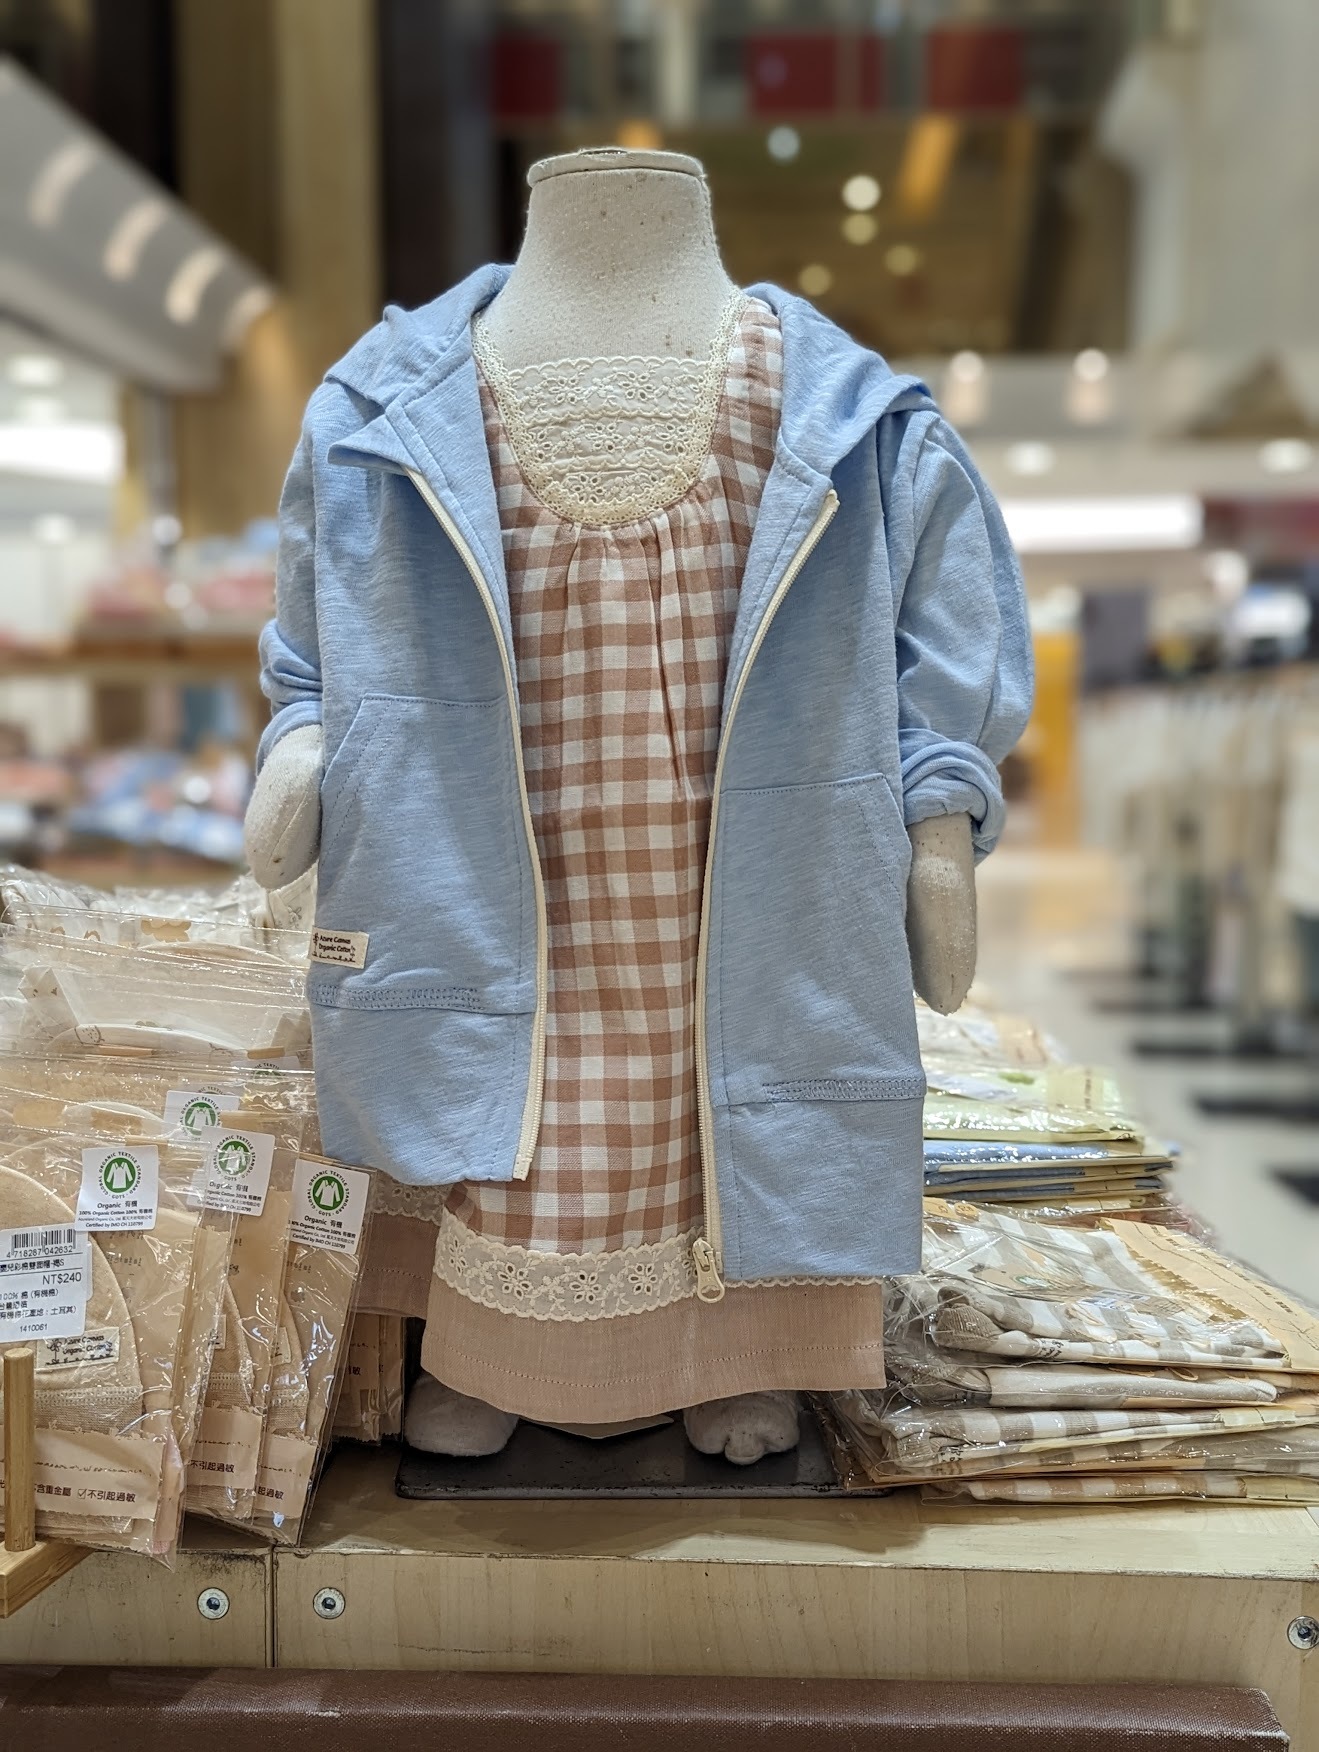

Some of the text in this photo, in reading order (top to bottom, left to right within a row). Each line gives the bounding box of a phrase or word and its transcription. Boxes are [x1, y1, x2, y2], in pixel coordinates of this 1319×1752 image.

[236, 1135, 254, 1149] TEXTILE
[99, 1153, 116, 1173] ORGANIC
[118, 1152, 137, 1163] TEXTILE
[130, 1165, 141, 1194] STANDARD
[309, 1170, 328, 1186] ORGANIC
[330, 1170, 347, 1186] TEXTILE
[336, 1188, 350, 1214] STANDARD
[304, 1216, 327, 1225] Organic
[42, 1272, 82, 1285] NT$240
[20, 1324, 48, 1332] 1410061
[190, 1460, 235, 1473] 不引起過敏
[87, 1489, 136, 1502] 不引起過敏
